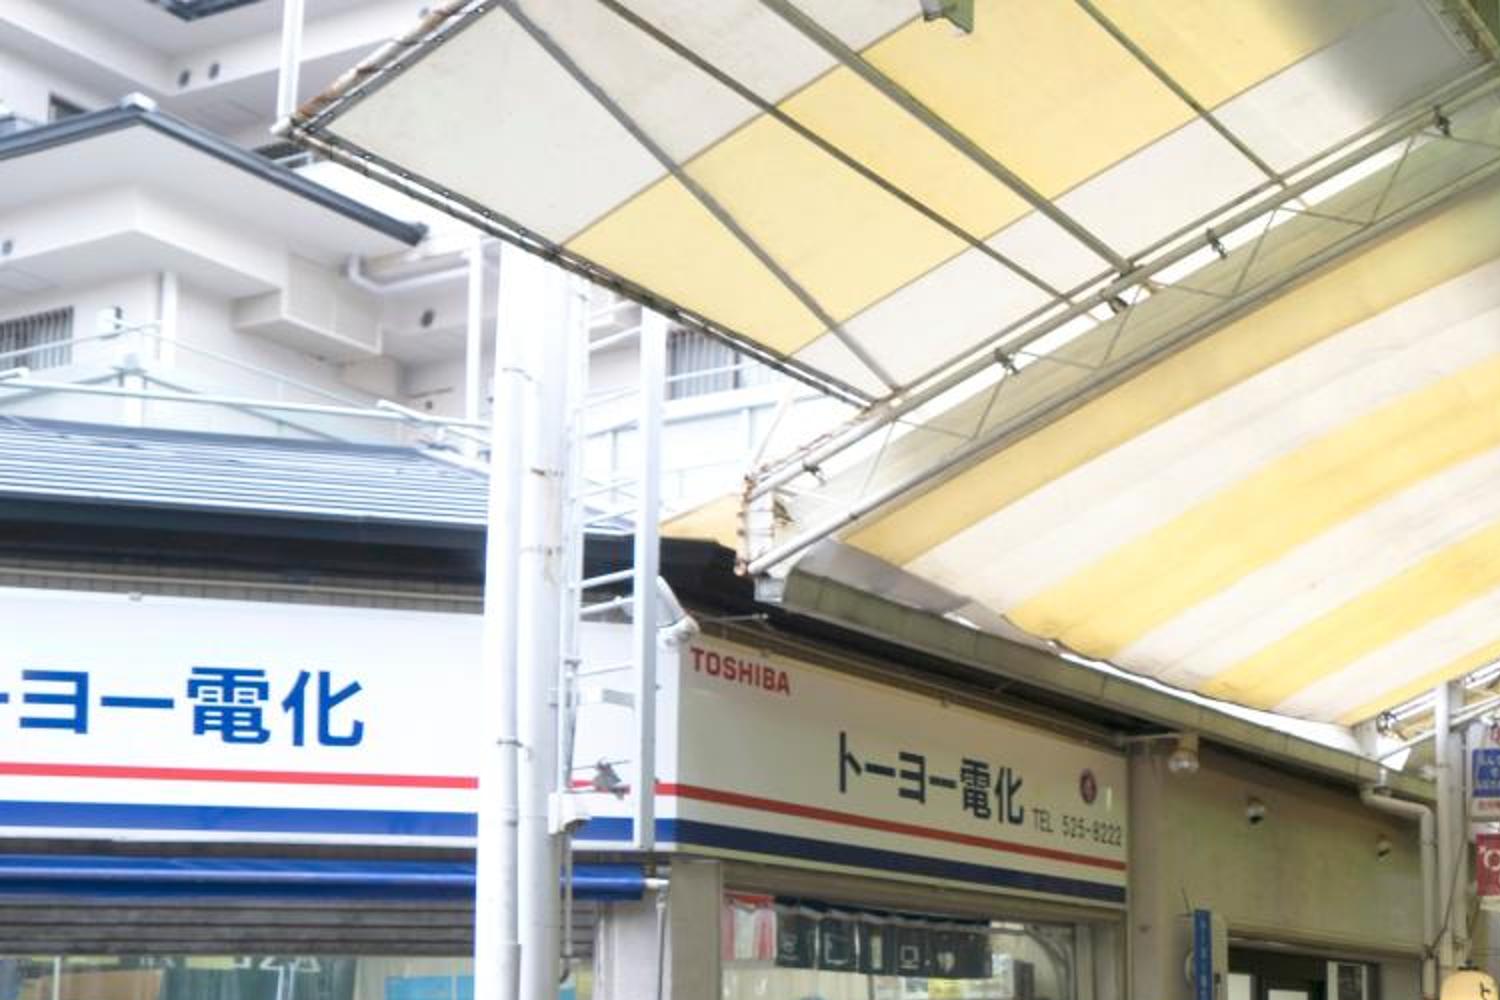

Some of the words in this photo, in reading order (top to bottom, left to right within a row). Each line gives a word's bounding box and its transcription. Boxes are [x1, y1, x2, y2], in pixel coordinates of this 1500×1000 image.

[690, 647, 790, 695] TOSHIBA
[0, 666, 364, 747] ヨー電化
[838, 731, 1025, 826] トーヨー電化
[1032, 808, 1053, 832] TEL
